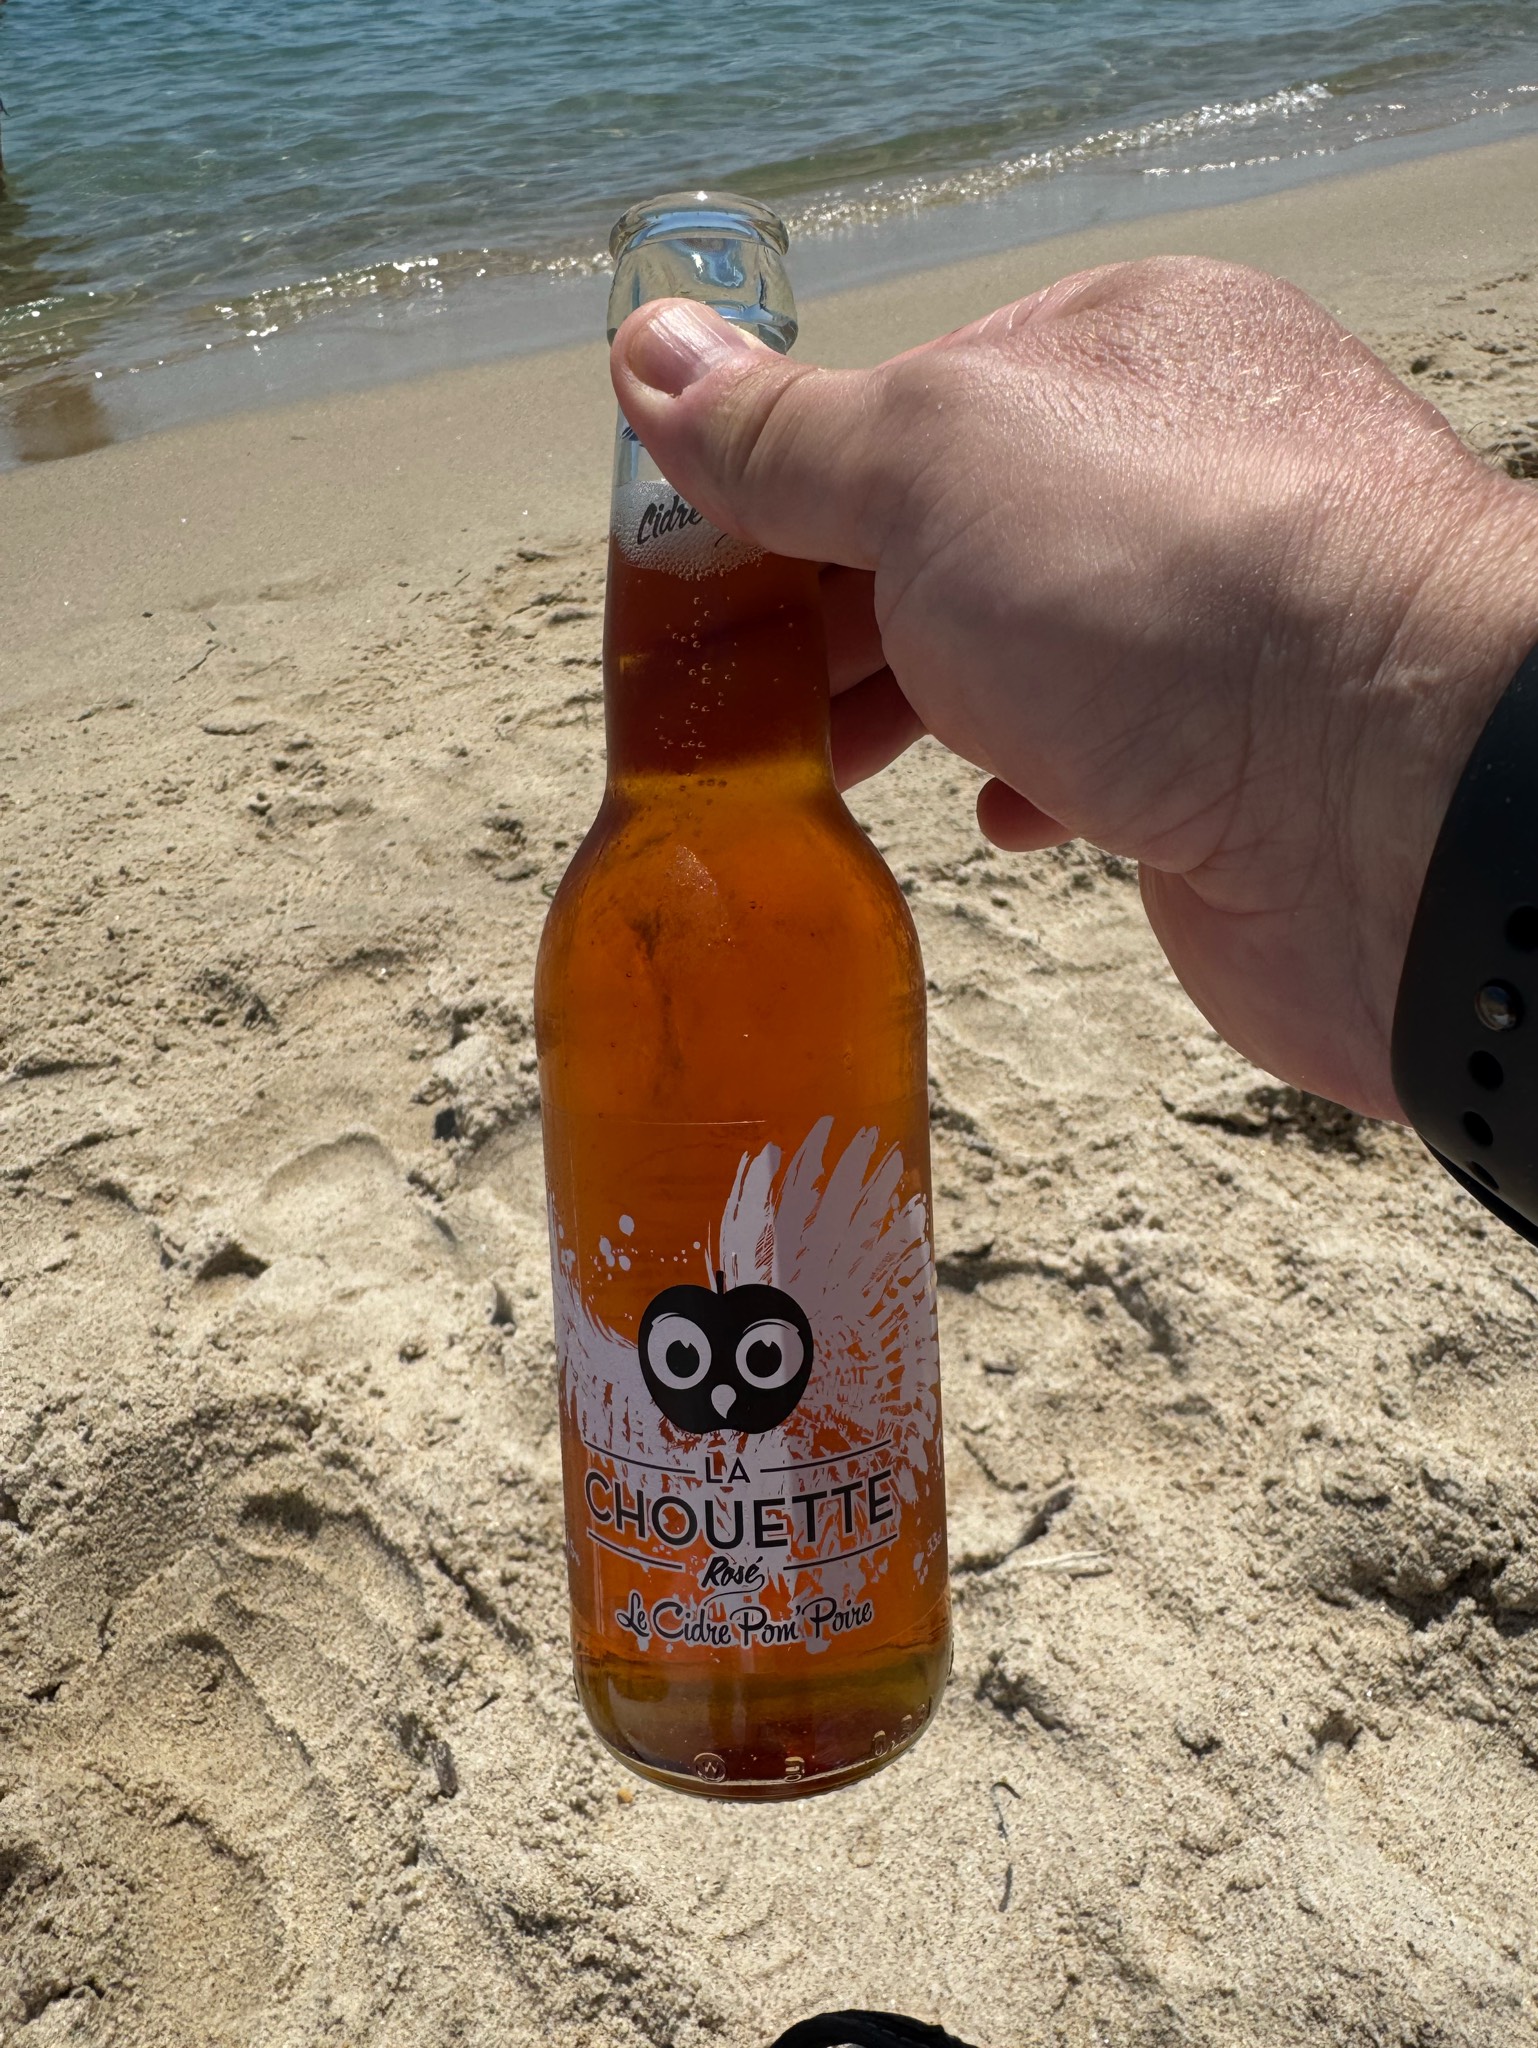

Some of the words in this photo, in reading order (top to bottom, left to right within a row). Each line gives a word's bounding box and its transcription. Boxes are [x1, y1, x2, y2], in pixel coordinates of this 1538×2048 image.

[637, 495, 703, 545] Cidre
[705, 1457, 750, 1484] LA
[585, 1469, 894, 1550] CHOUETTE
[701, 1555, 765, 1600] Rosé
[617, 1592, 649, 1637] Le
[653, 1601, 731, 1645] Cidre
[802, 1597, 872, 1638] Poire
